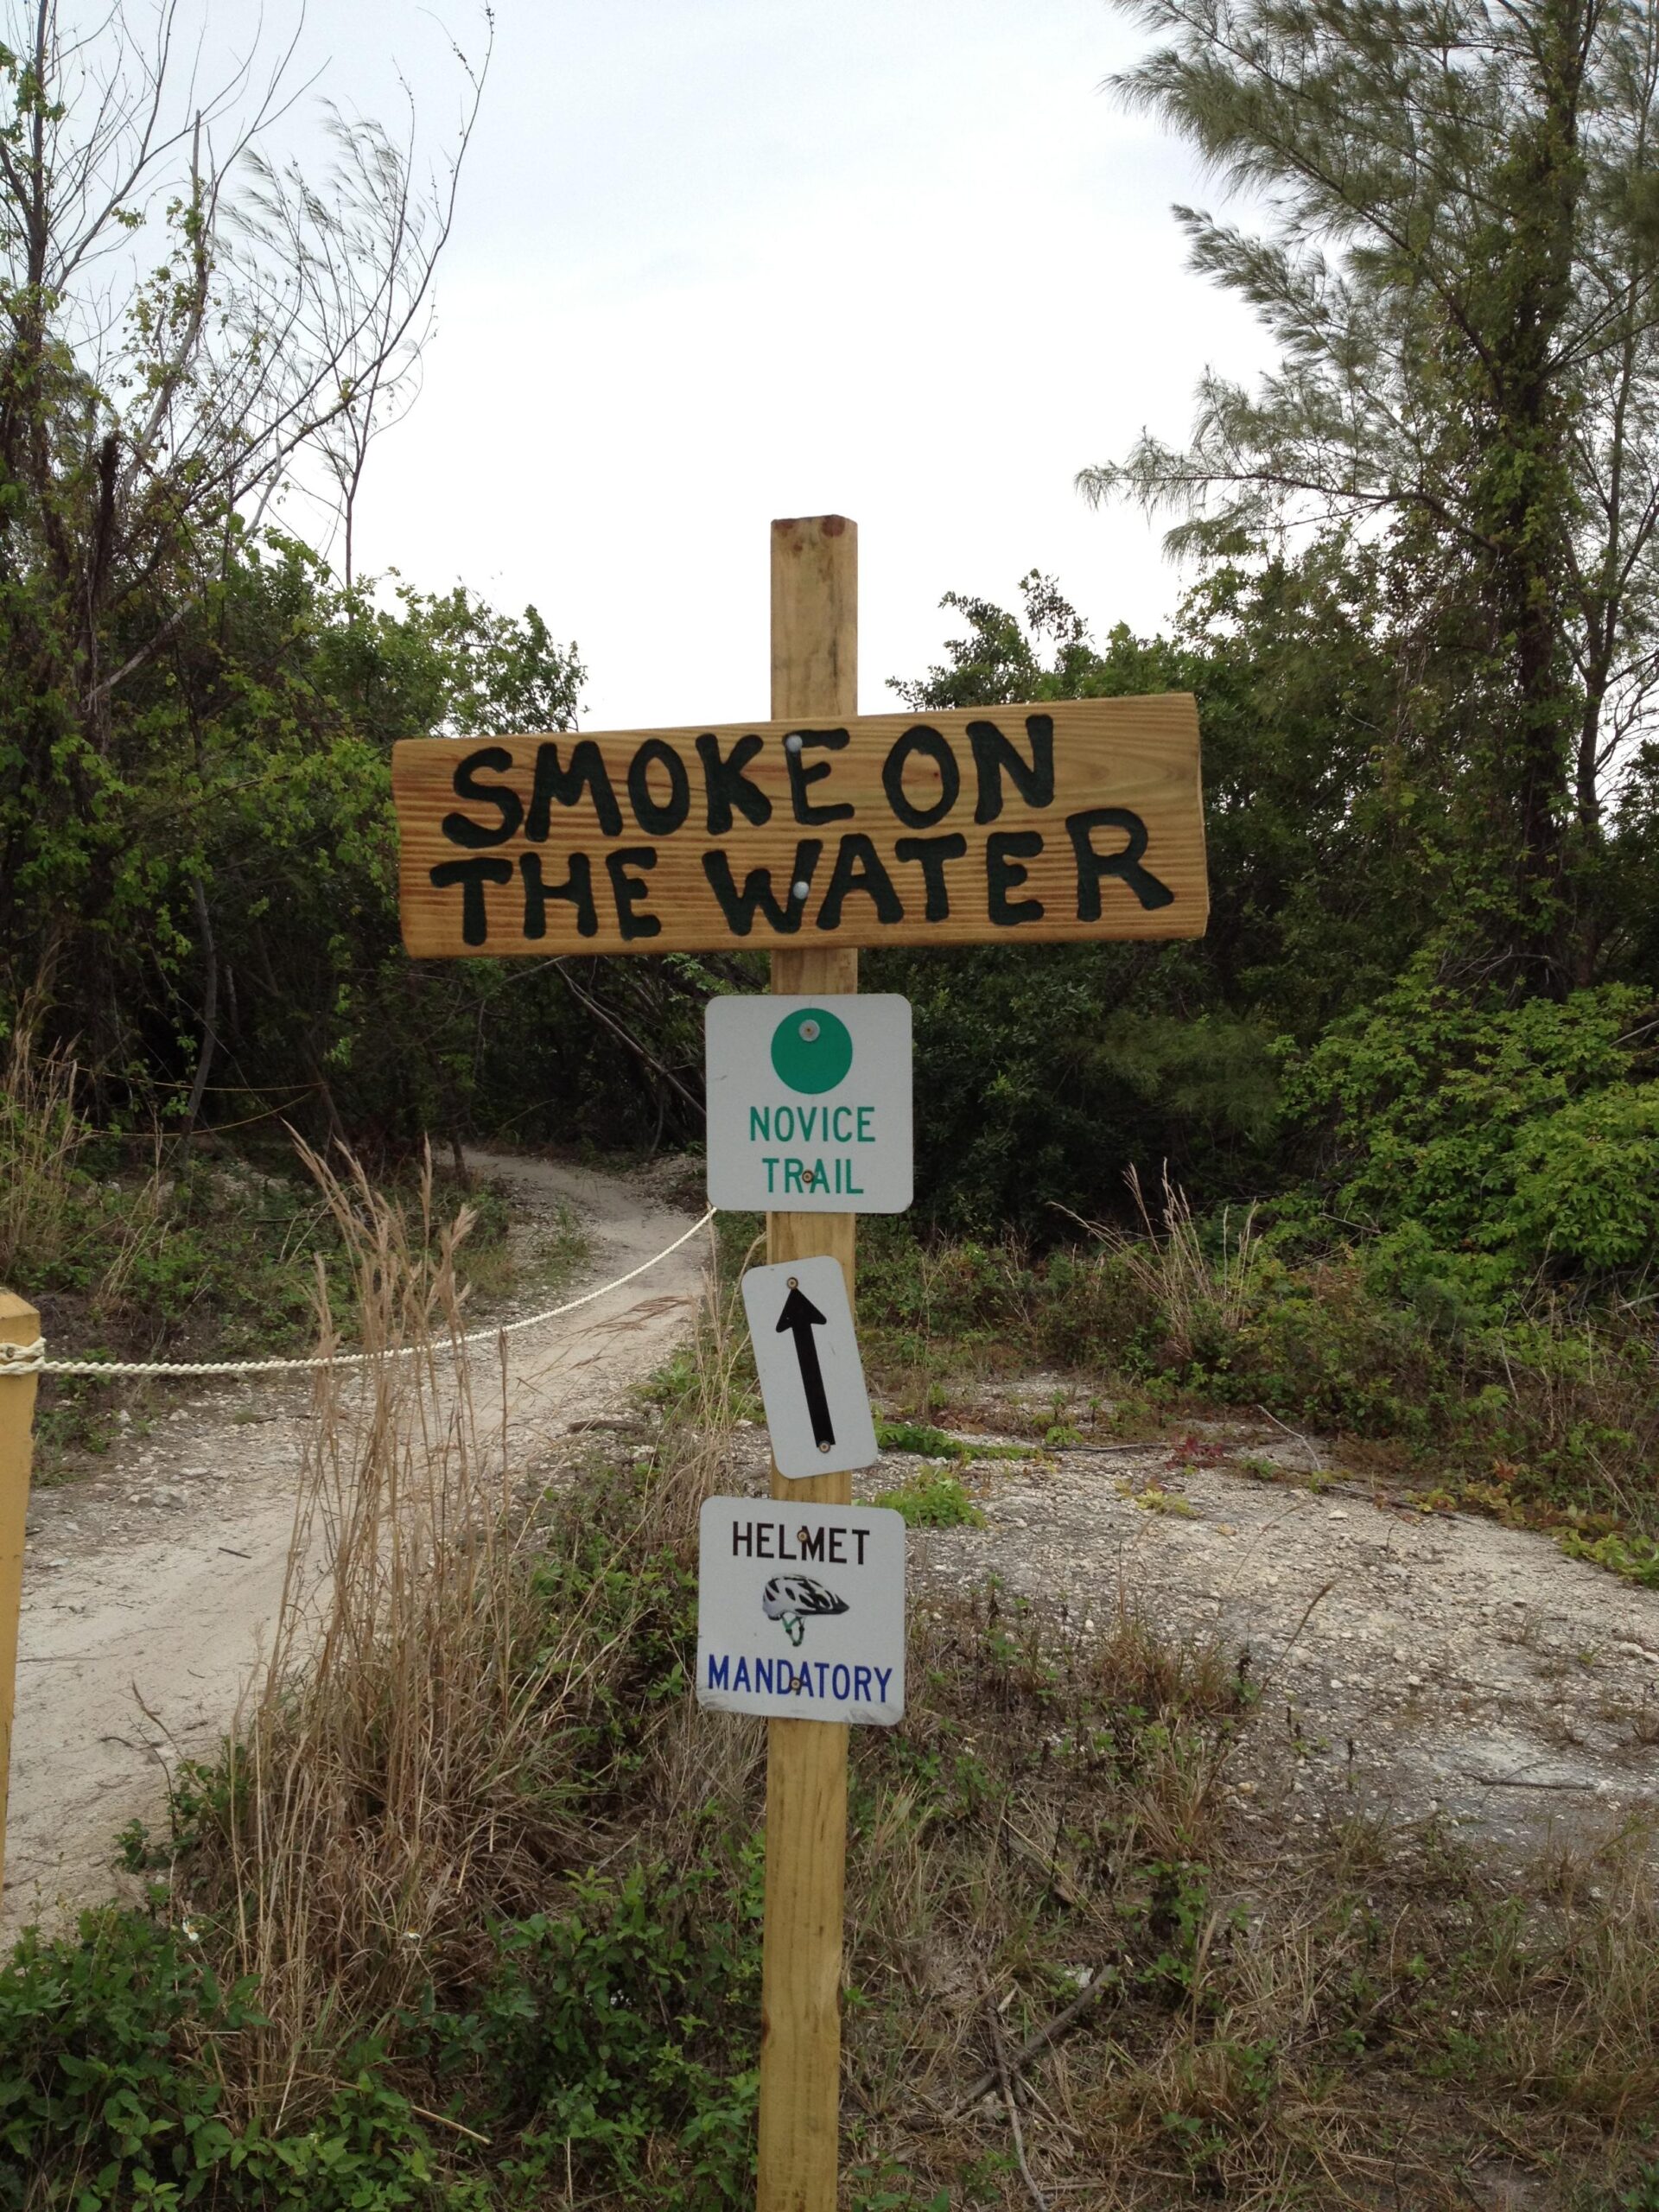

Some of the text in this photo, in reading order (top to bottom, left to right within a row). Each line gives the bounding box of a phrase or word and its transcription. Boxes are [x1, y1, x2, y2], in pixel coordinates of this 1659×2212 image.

[442, 714, 1055, 849] SMOKE ON
[429, 807, 1174, 946] THE WATER
[750, 1106, 875, 1142] NOVICE
[761, 1158, 864, 1194] TRAIL
[733, 1521, 870, 1565] HELMET
[708, 1654, 893, 1703] MANDATORY
